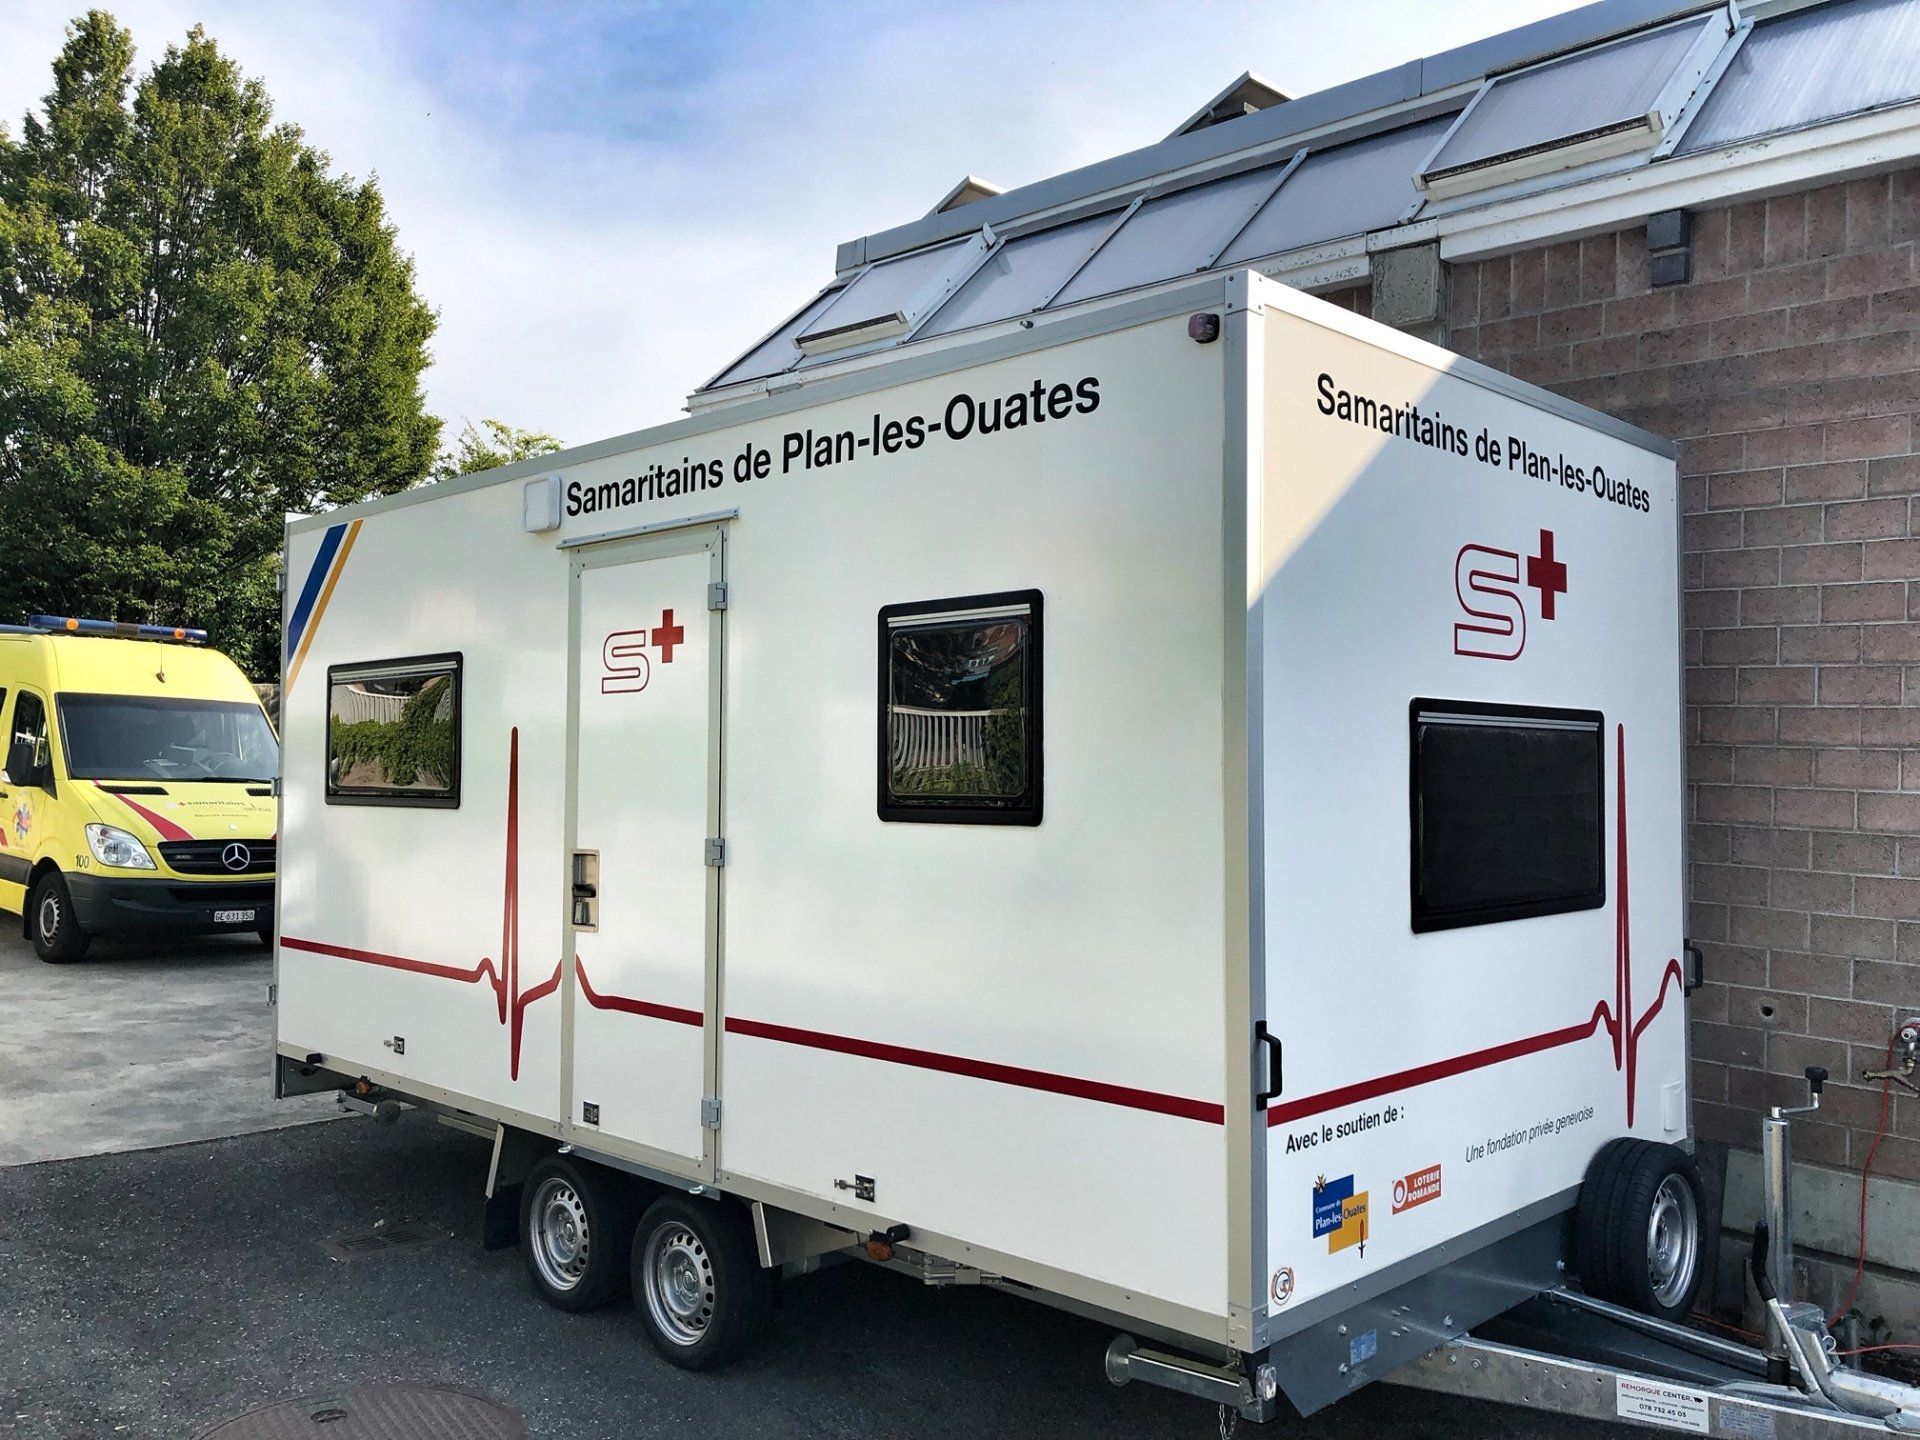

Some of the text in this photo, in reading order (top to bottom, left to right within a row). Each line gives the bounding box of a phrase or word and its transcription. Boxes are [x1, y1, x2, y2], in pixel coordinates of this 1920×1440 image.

[566, 376, 1101, 517] Samaritains de Plan-les-Ouates
[1317, 373, 1650, 513] Samaritains de Plan-les-Ouates
[76, 854, 90, 869] 100
[215, 912, 225, 921] GE
[1286, 1133, 1318, 1155] Avec
[1322, 1124, 1333, 1143] le
[1336, 1112, 1381, 1138] soutien
[1383, 1105, 1398, 1124] de
[1465, 1106, 1594, 1162] Une fondation privée genevoise
[1413, 1170, 1440, 1188] LOTERIE
[1408, 1182, 1440, 1203] ROMANDE
[1621, 1382, 1661, 1396] REMORQUE
[1639, 1403, 1652, 1411] 078
